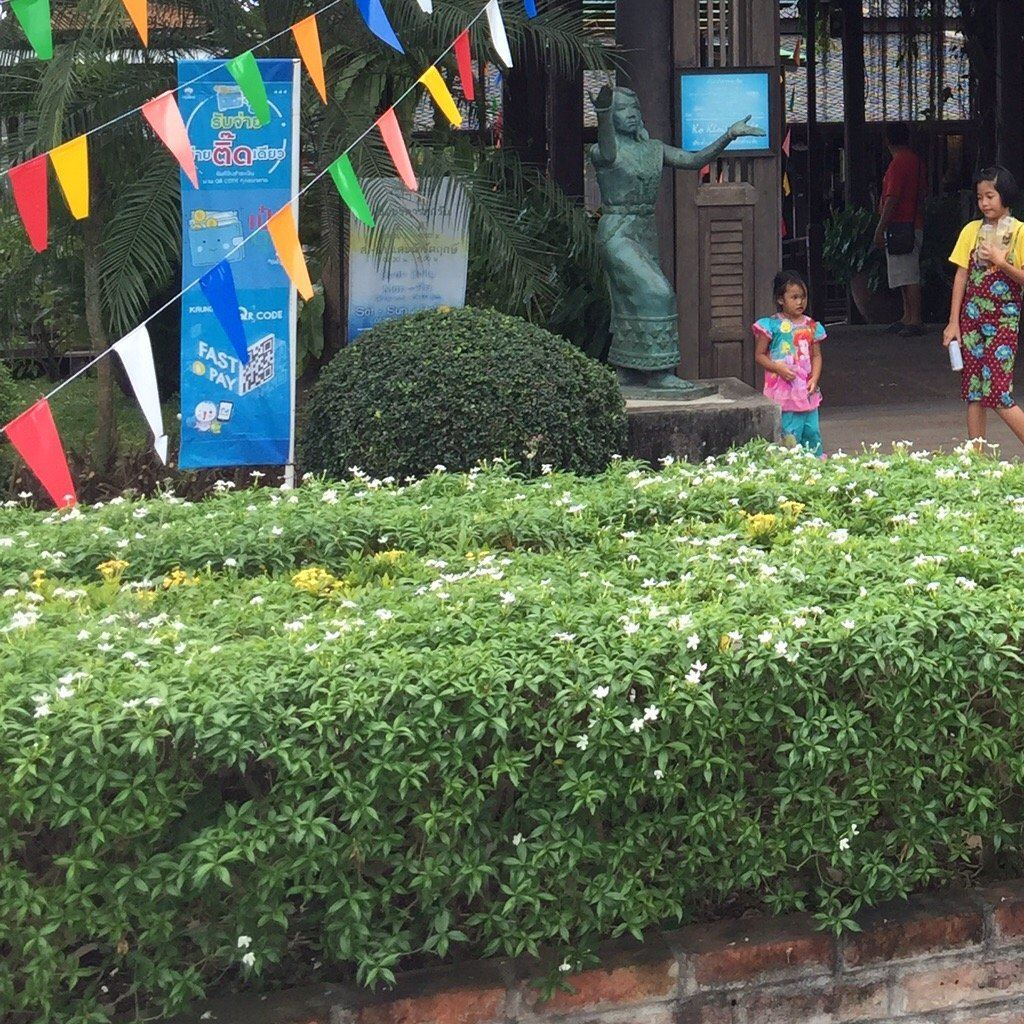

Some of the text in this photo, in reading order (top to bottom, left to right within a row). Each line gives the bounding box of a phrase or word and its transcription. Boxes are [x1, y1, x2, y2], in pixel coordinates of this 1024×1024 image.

[256, 310, 283, 320] CODE
[199, 341, 239, 373] FAST
[209, 367, 236, 391] PAY
